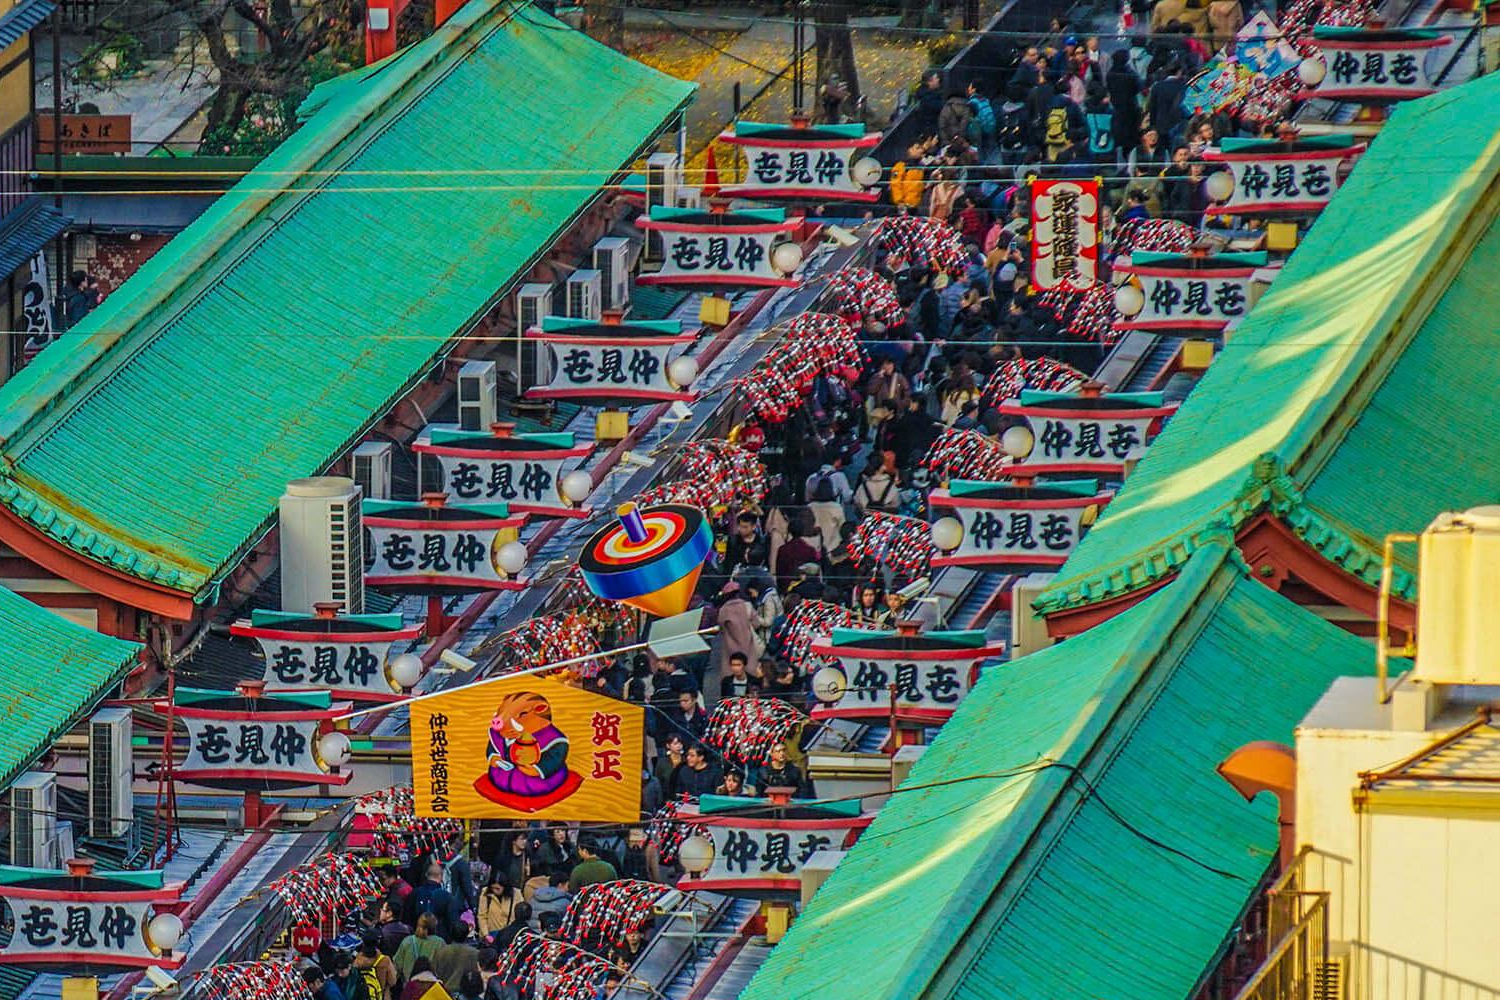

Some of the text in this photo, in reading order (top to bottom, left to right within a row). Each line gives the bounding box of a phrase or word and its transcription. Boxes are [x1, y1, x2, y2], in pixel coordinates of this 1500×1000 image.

[428, 713, 450, 813] 仲見世商店会
[591, 711, 624, 781] 賀正
